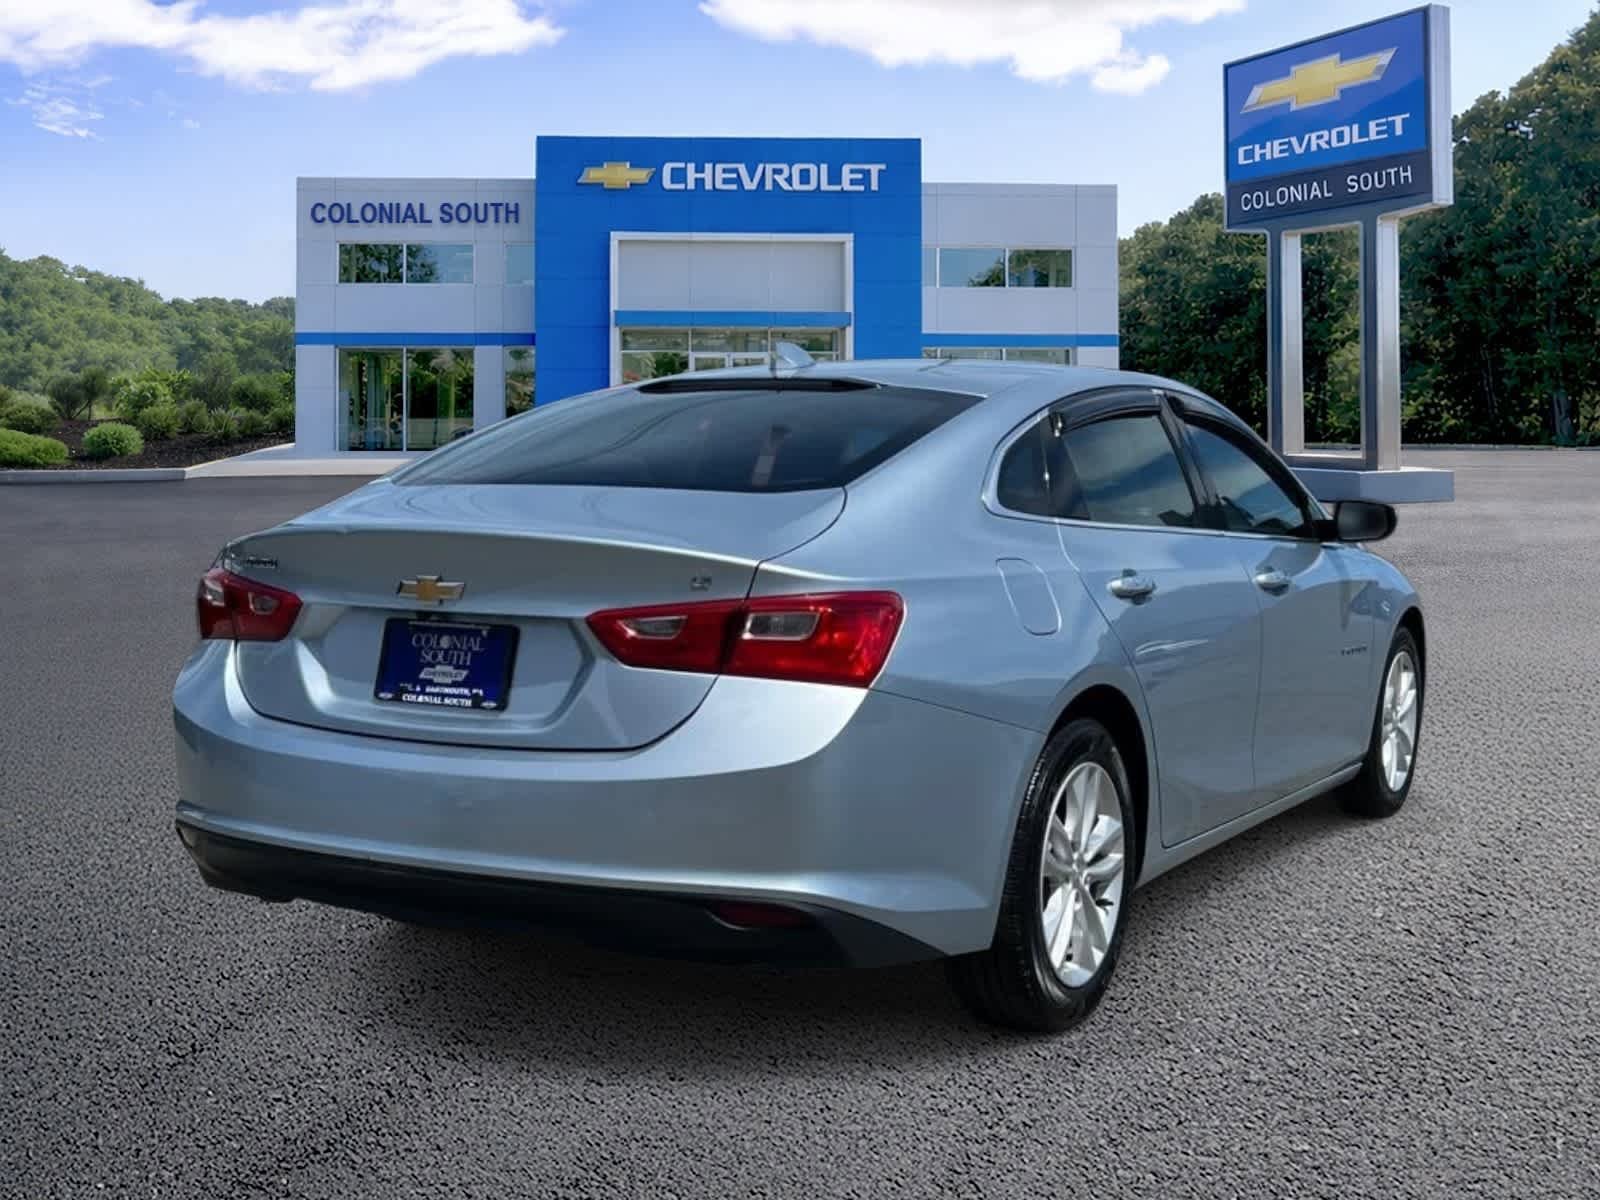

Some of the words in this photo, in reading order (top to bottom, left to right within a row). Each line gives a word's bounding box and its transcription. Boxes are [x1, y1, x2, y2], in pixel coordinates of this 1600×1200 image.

[1237, 113, 1410, 165] CHEVROLET
[662, 161, 887, 192] CHEVROLET
[1240, 180, 1333, 211] COLONIAL
[1346, 165, 1413, 193] SOUTH
[310, 202, 433, 224] COLONIAL
[439, 202, 520, 224] SOUTH
[411, 632, 483, 651] COLONIAL
[419, 650, 472, 665] SOUTH
[402, 693, 442, 705] COLONIAL
[443, 697, 472, 707] SOUTH
